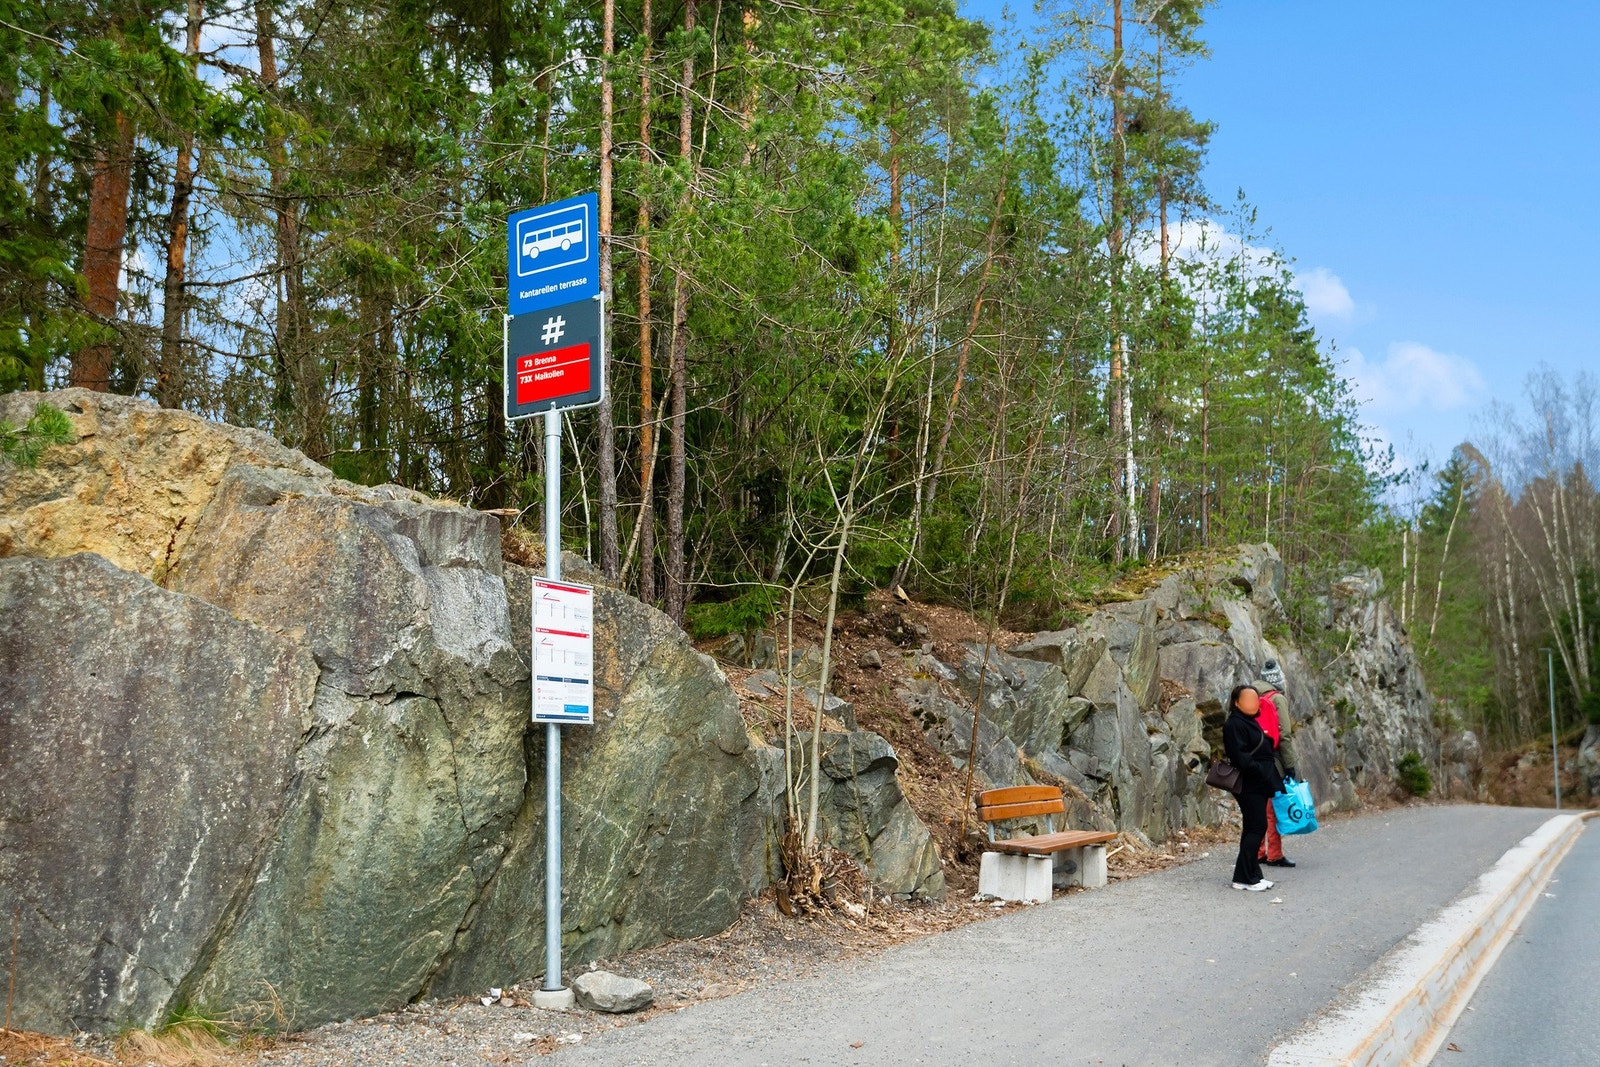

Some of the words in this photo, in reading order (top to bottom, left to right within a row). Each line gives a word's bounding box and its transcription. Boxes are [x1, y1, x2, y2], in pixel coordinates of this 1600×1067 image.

[520, 284, 558, 299] Kantarellen
[559, 277, 587, 290] terrasse
[524, 359, 533, 368] 73
[534, 355, 556, 365] Brenna
[520, 375, 533, 384] 73X
